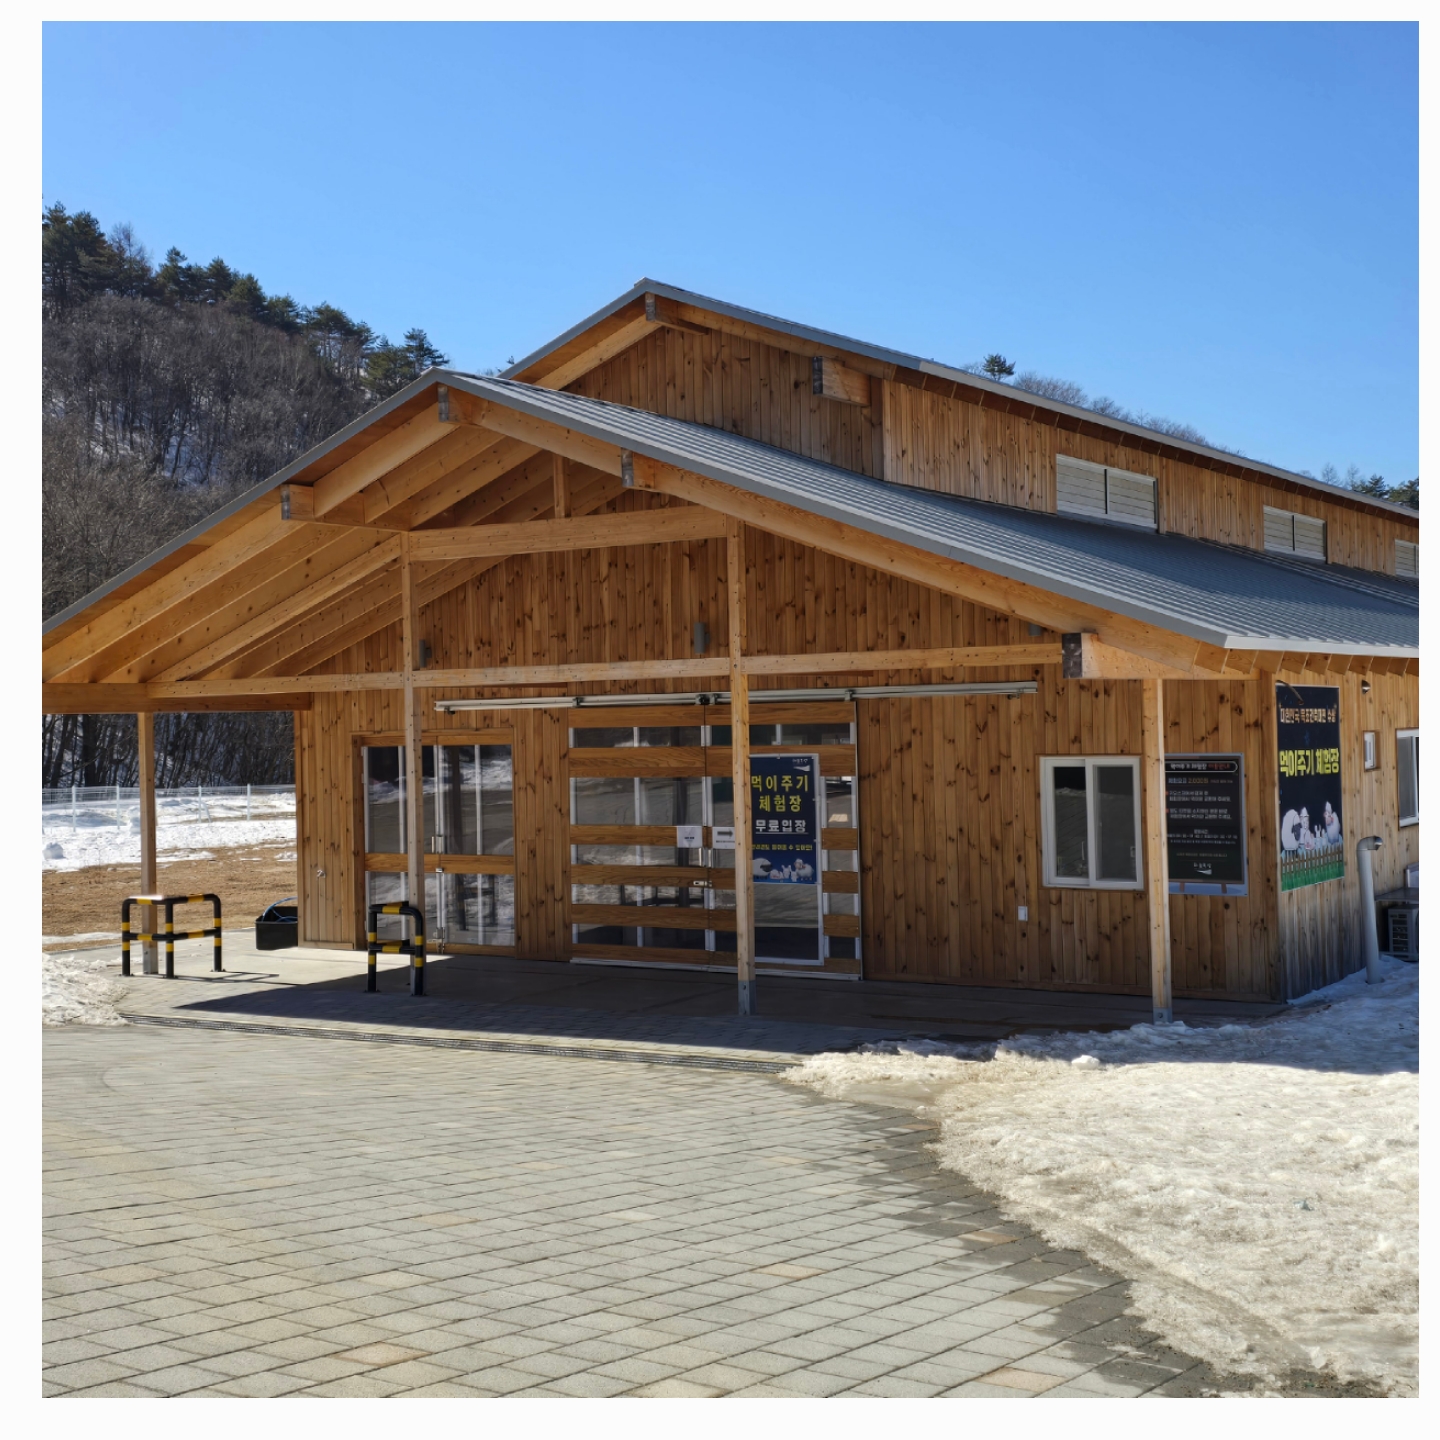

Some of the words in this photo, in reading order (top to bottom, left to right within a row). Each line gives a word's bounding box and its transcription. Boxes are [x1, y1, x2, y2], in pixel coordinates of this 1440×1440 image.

[1280, 749, 1314, 778] 먹이주기
[1316, 748, 1340, 775] 체험장
[751, 774, 808, 792] 먹이주기
[759, 794, 802, 812] 체험장
[756, 819, 806, 832] 무료입장
